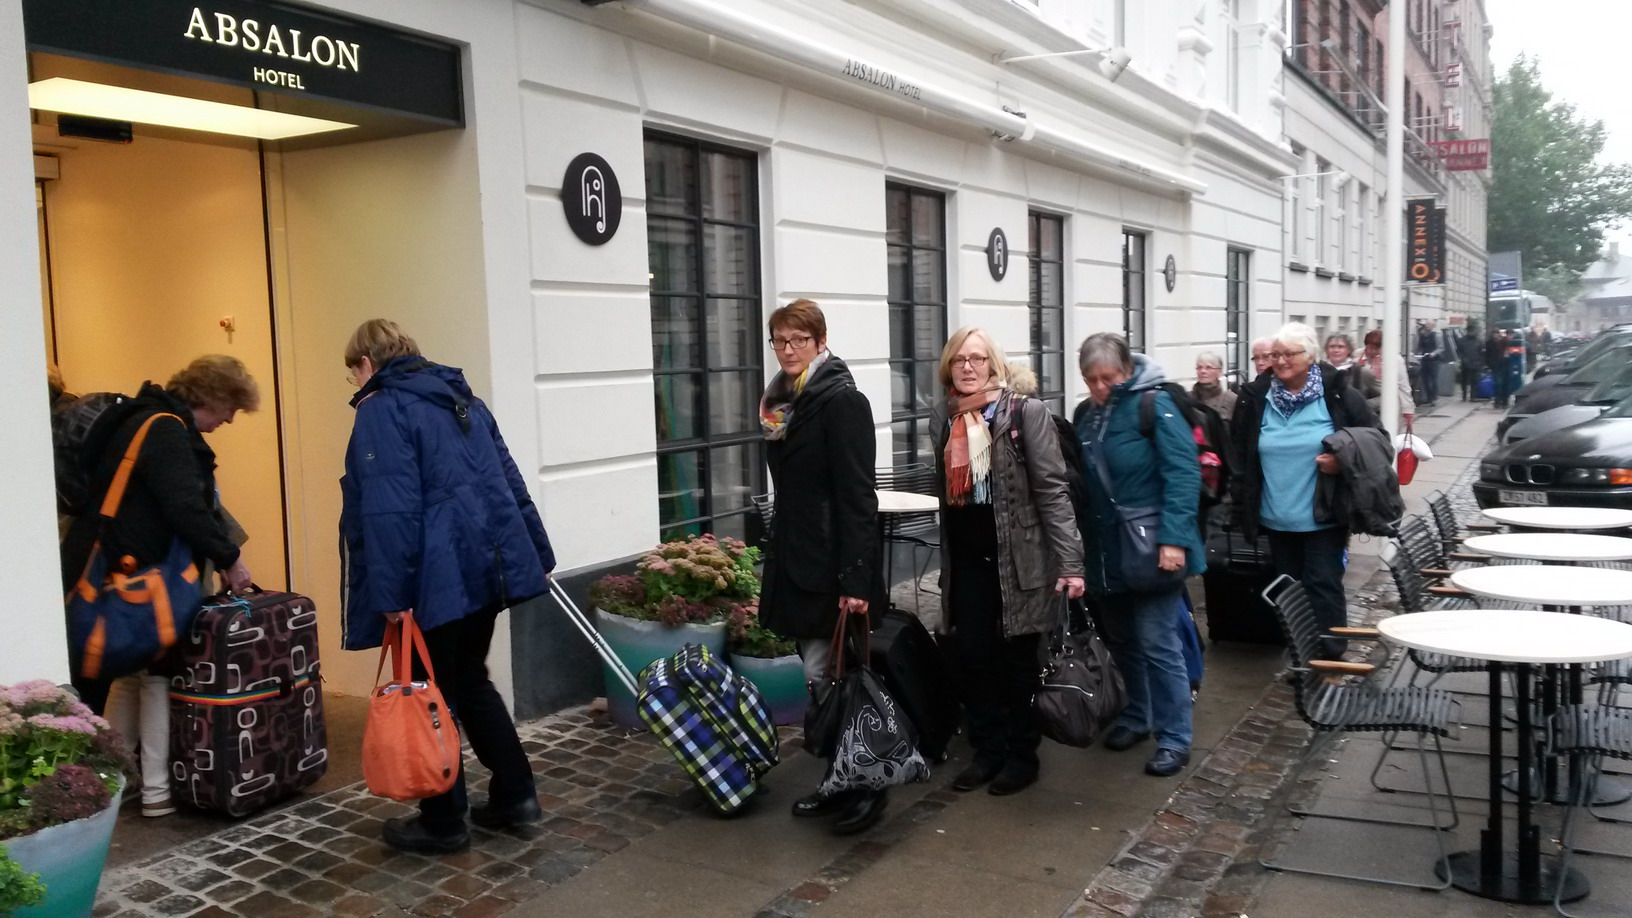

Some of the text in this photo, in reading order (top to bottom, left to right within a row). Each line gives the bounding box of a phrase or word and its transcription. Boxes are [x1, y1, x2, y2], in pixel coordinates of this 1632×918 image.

[183, 7, 360, 72] ABSALON
[253, 66, 305, 90] HOTEL
[842, 58, 922, 100] ABSALON HOTEL
